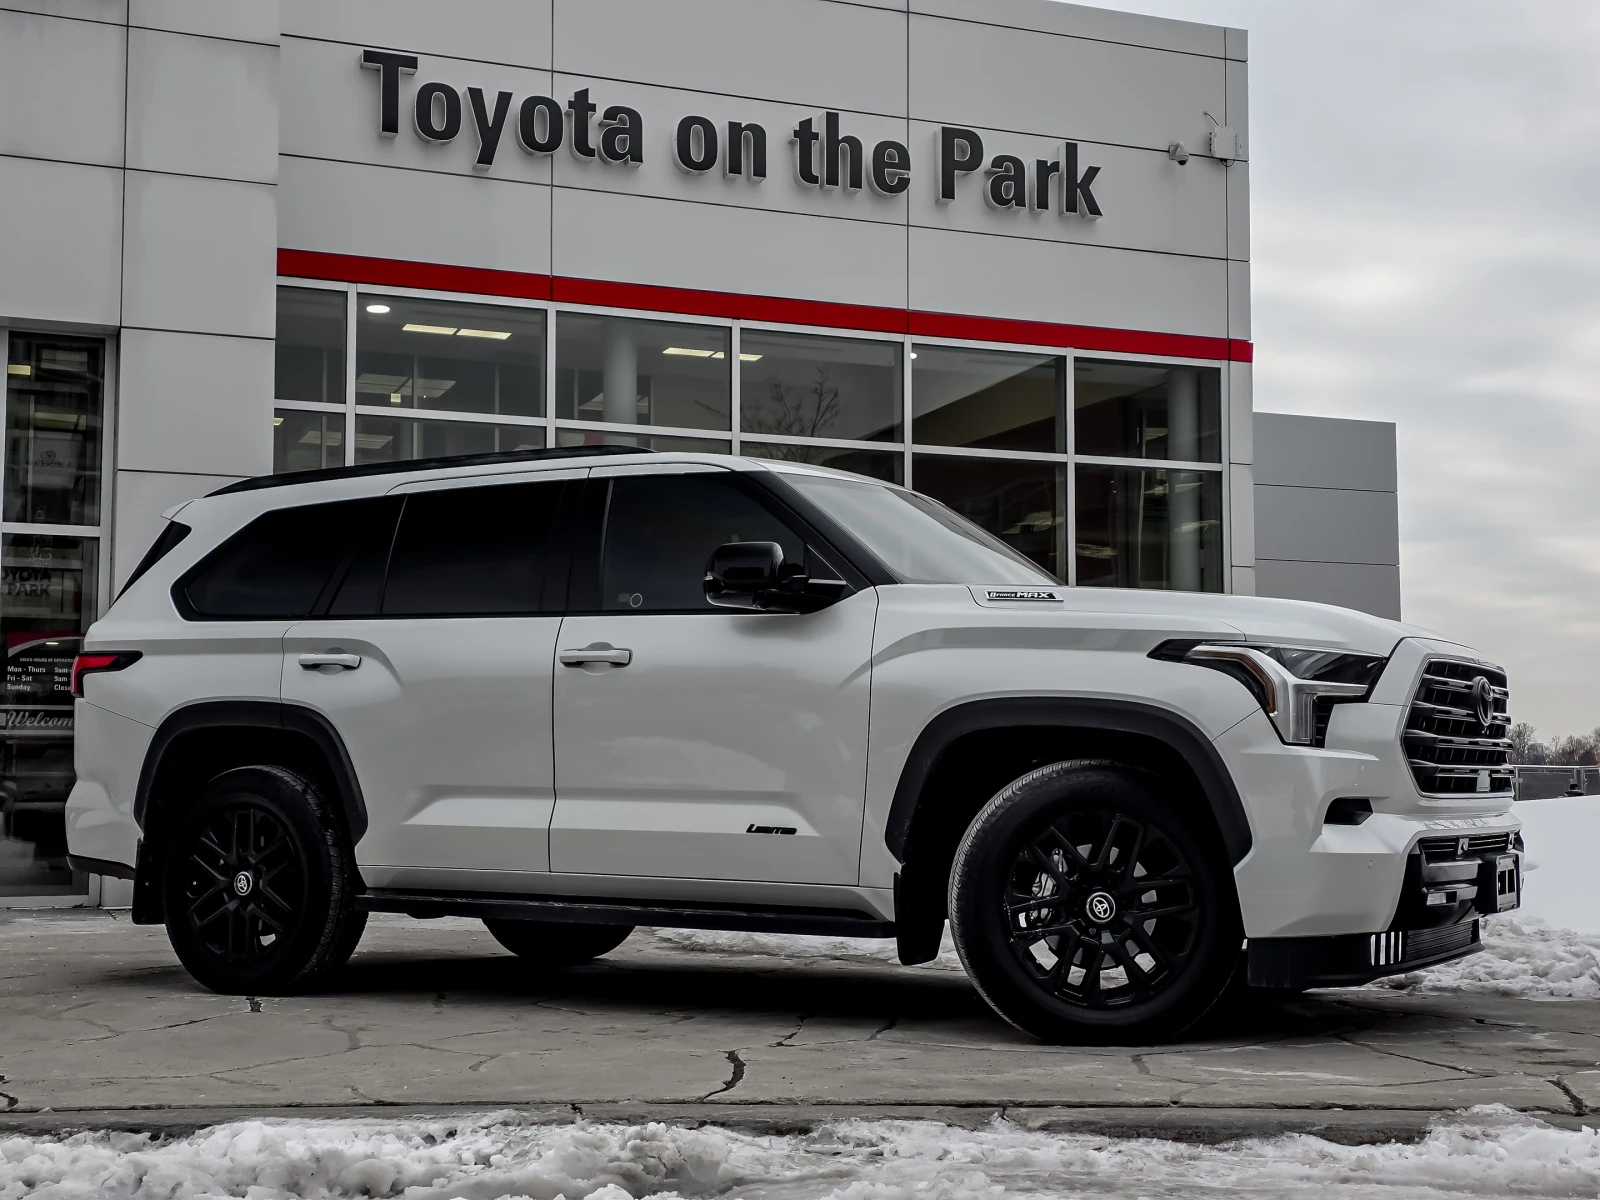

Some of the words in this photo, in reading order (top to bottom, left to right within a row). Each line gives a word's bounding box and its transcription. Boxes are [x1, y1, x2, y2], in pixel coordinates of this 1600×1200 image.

[361, 49, 644, 171] Toyota
[673, 113, 768, 183] on
[789, 110, 912, 196] the
[935, 125, 1104, 220] Park
[1, 567, 52, 582] OYOTA
[7, 674, 16, 682] Fri
[21, 674, 32, 682] Sat
[7, 711, 74, 727] Welcom
